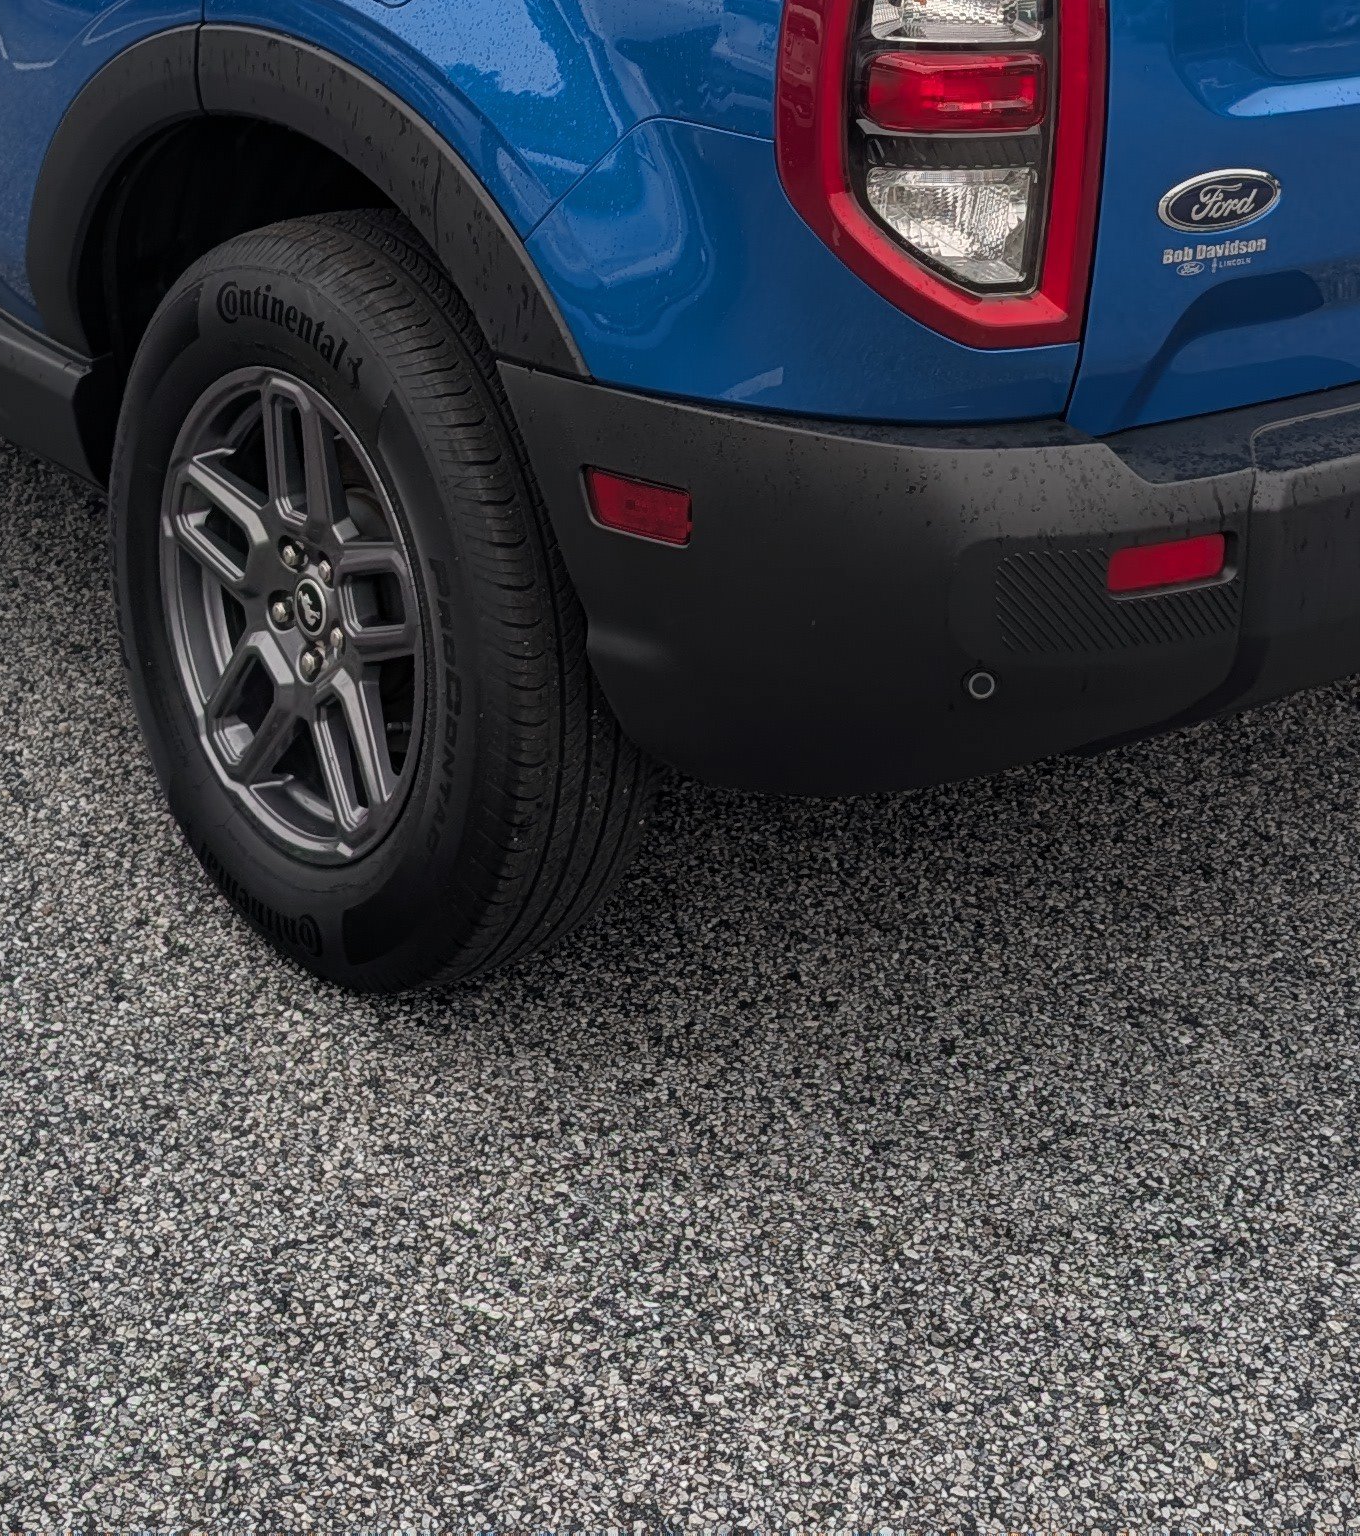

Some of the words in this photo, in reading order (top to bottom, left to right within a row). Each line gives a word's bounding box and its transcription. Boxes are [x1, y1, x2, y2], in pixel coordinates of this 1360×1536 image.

[1162, 247, 1193, 264] Bob
[1196, 237, 1267, 260] Davidson
[217, 280, 349, 372] Continental
